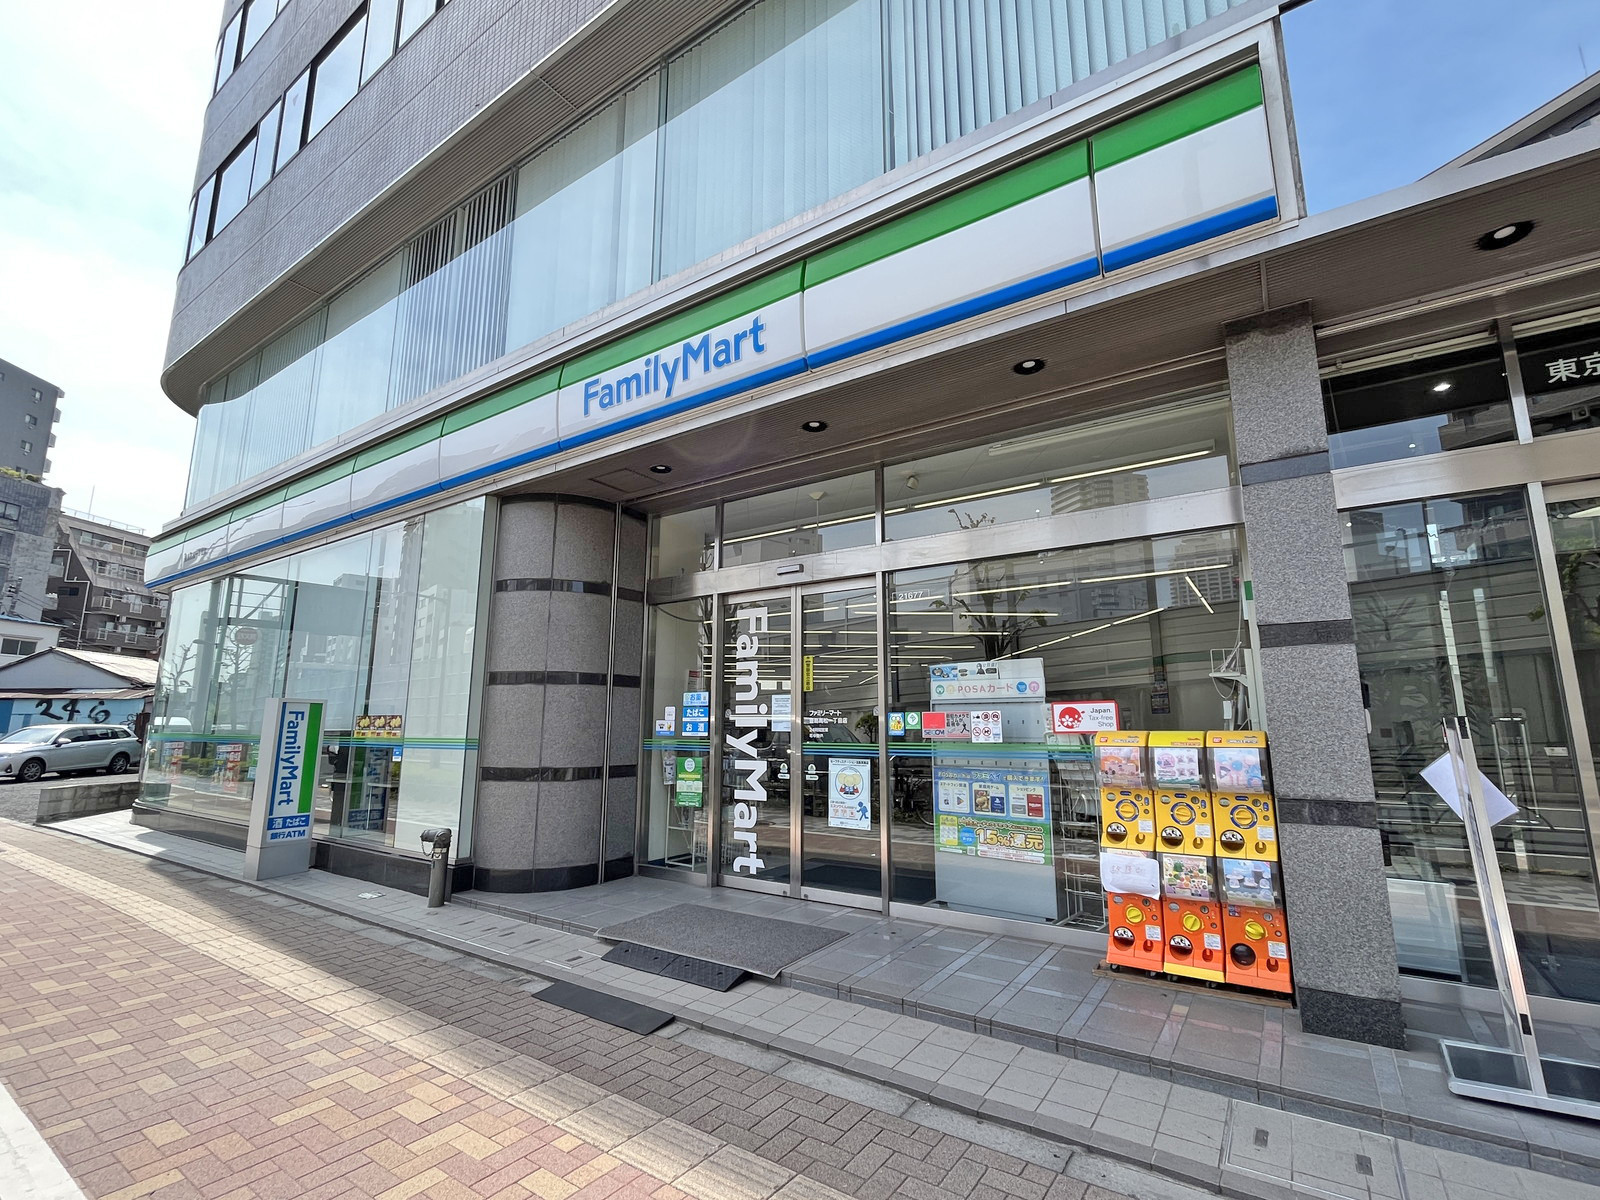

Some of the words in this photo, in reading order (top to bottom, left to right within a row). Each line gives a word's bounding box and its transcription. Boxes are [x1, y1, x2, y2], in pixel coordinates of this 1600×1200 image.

[584, 314, 766, 417] FamilyMart
[899, 591, 923, 600] 21677
[957, 683, 1013, 694] POSAカード
[35, 698, 111, 724] 246
[686, 708, 705, 717] たばこ
[809, 709, 842, 717] ファミリーマート
[725, 606, 768, 875] FamilyMart
[277, 710, 305, 806] FamilyMart
[285, 816, 306, 827] たばこ
